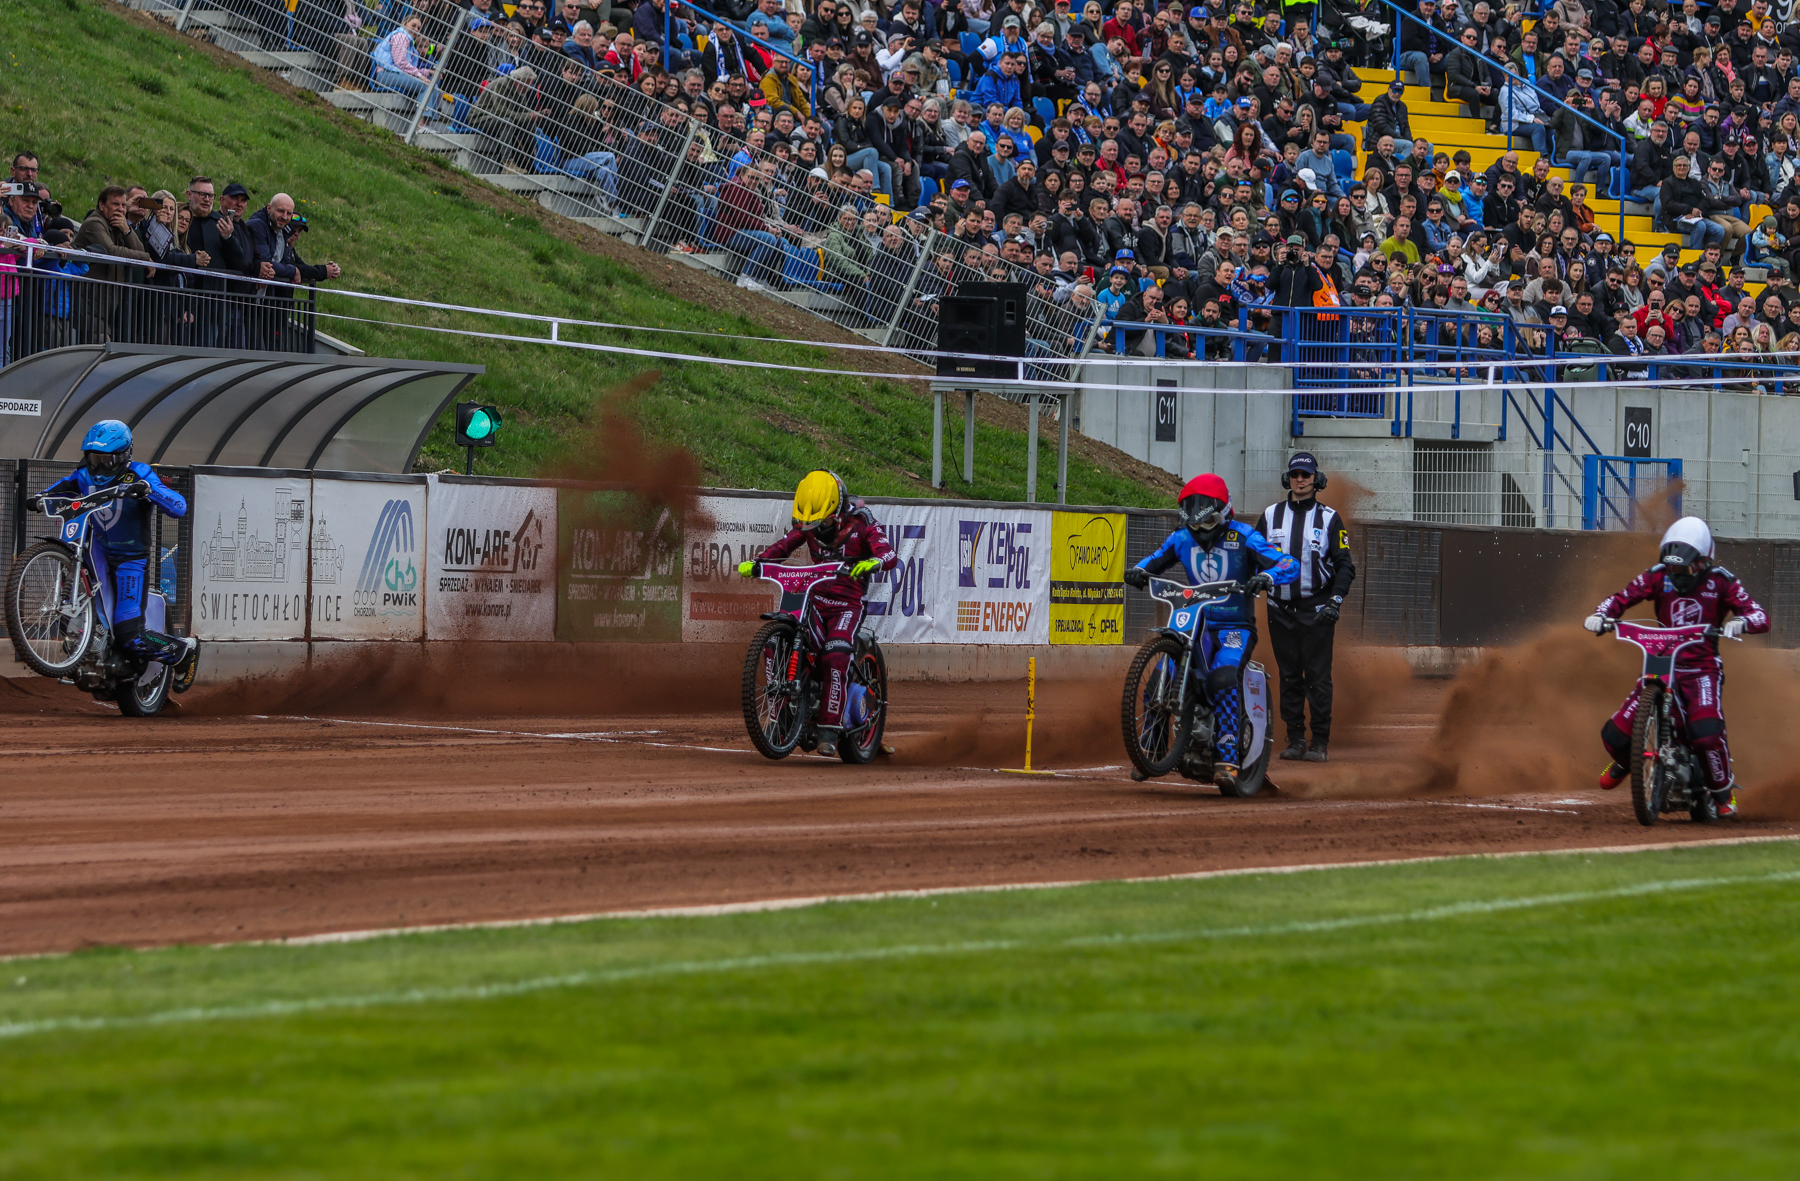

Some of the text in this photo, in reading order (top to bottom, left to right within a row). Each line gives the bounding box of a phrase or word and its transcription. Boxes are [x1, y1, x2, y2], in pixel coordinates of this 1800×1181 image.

[1158, 396, 1175, 425] C11
[1626, 422, 1650, 449] C10
[445, 528, 511, 567] KON-ARE
[573, 528, 644, 571] KON-ARE
[987, 522, 1015, 565] KEN
[1006, 545, 1031, 589] POL
[383, 592, 417, 607] PWiK
[439, 577, 469, 592] SPRZEDAŻ
[474, 578, 504, 593] WYNAJEM
[200, 586, 342, 627] ŚWIĘTOCHŁOWICE
[983, 601, 1032, 632] ENERGY
[1100, 619, 1118, 633] OPEL
